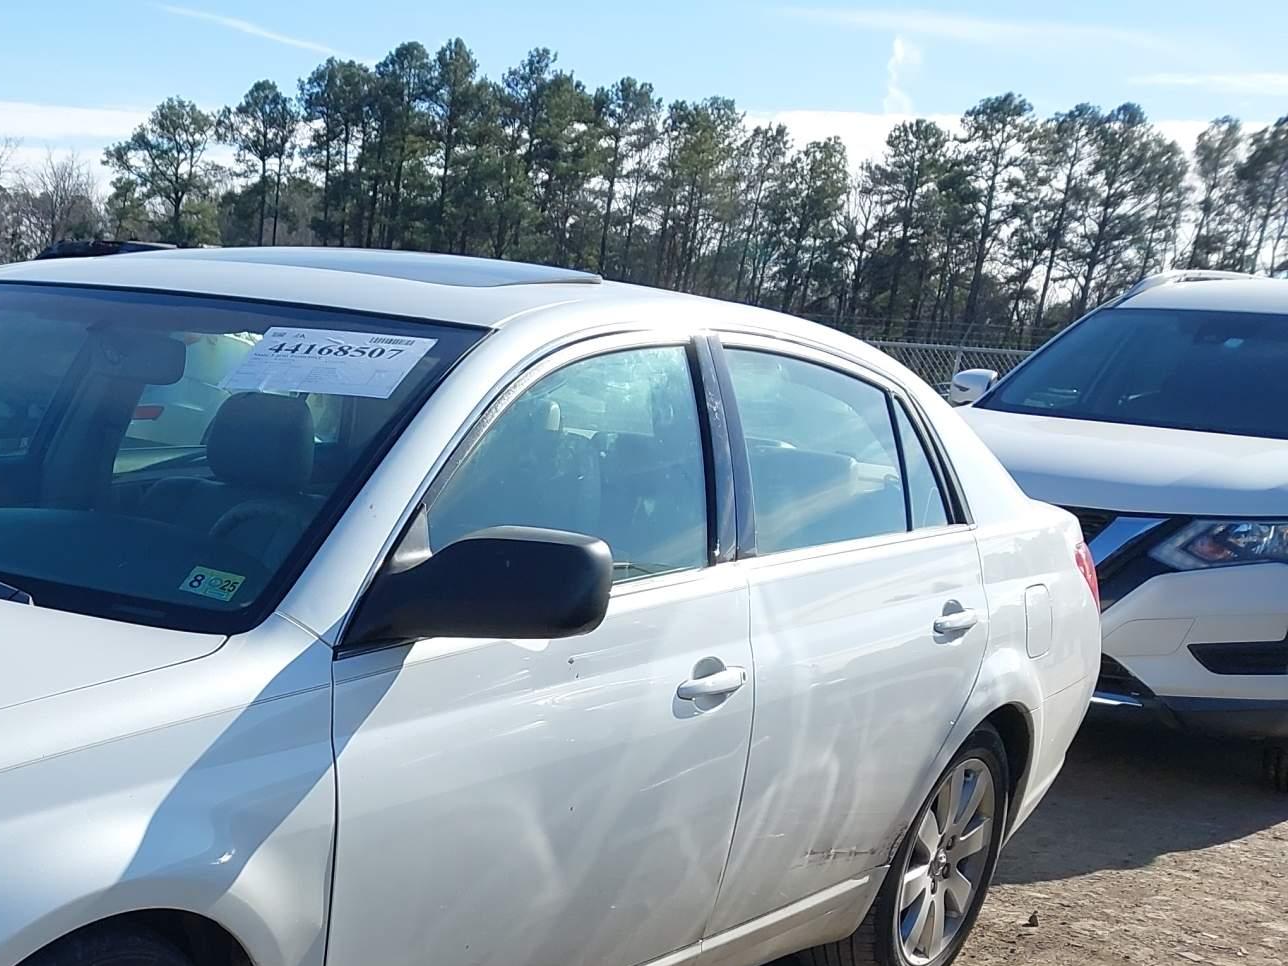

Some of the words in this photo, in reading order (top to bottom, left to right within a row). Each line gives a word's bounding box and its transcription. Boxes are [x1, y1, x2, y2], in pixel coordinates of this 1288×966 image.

[268, 341, 404, 360] 44168507
[189, 574, 205, 588] 8
[219, 579, 239, 593] 25
